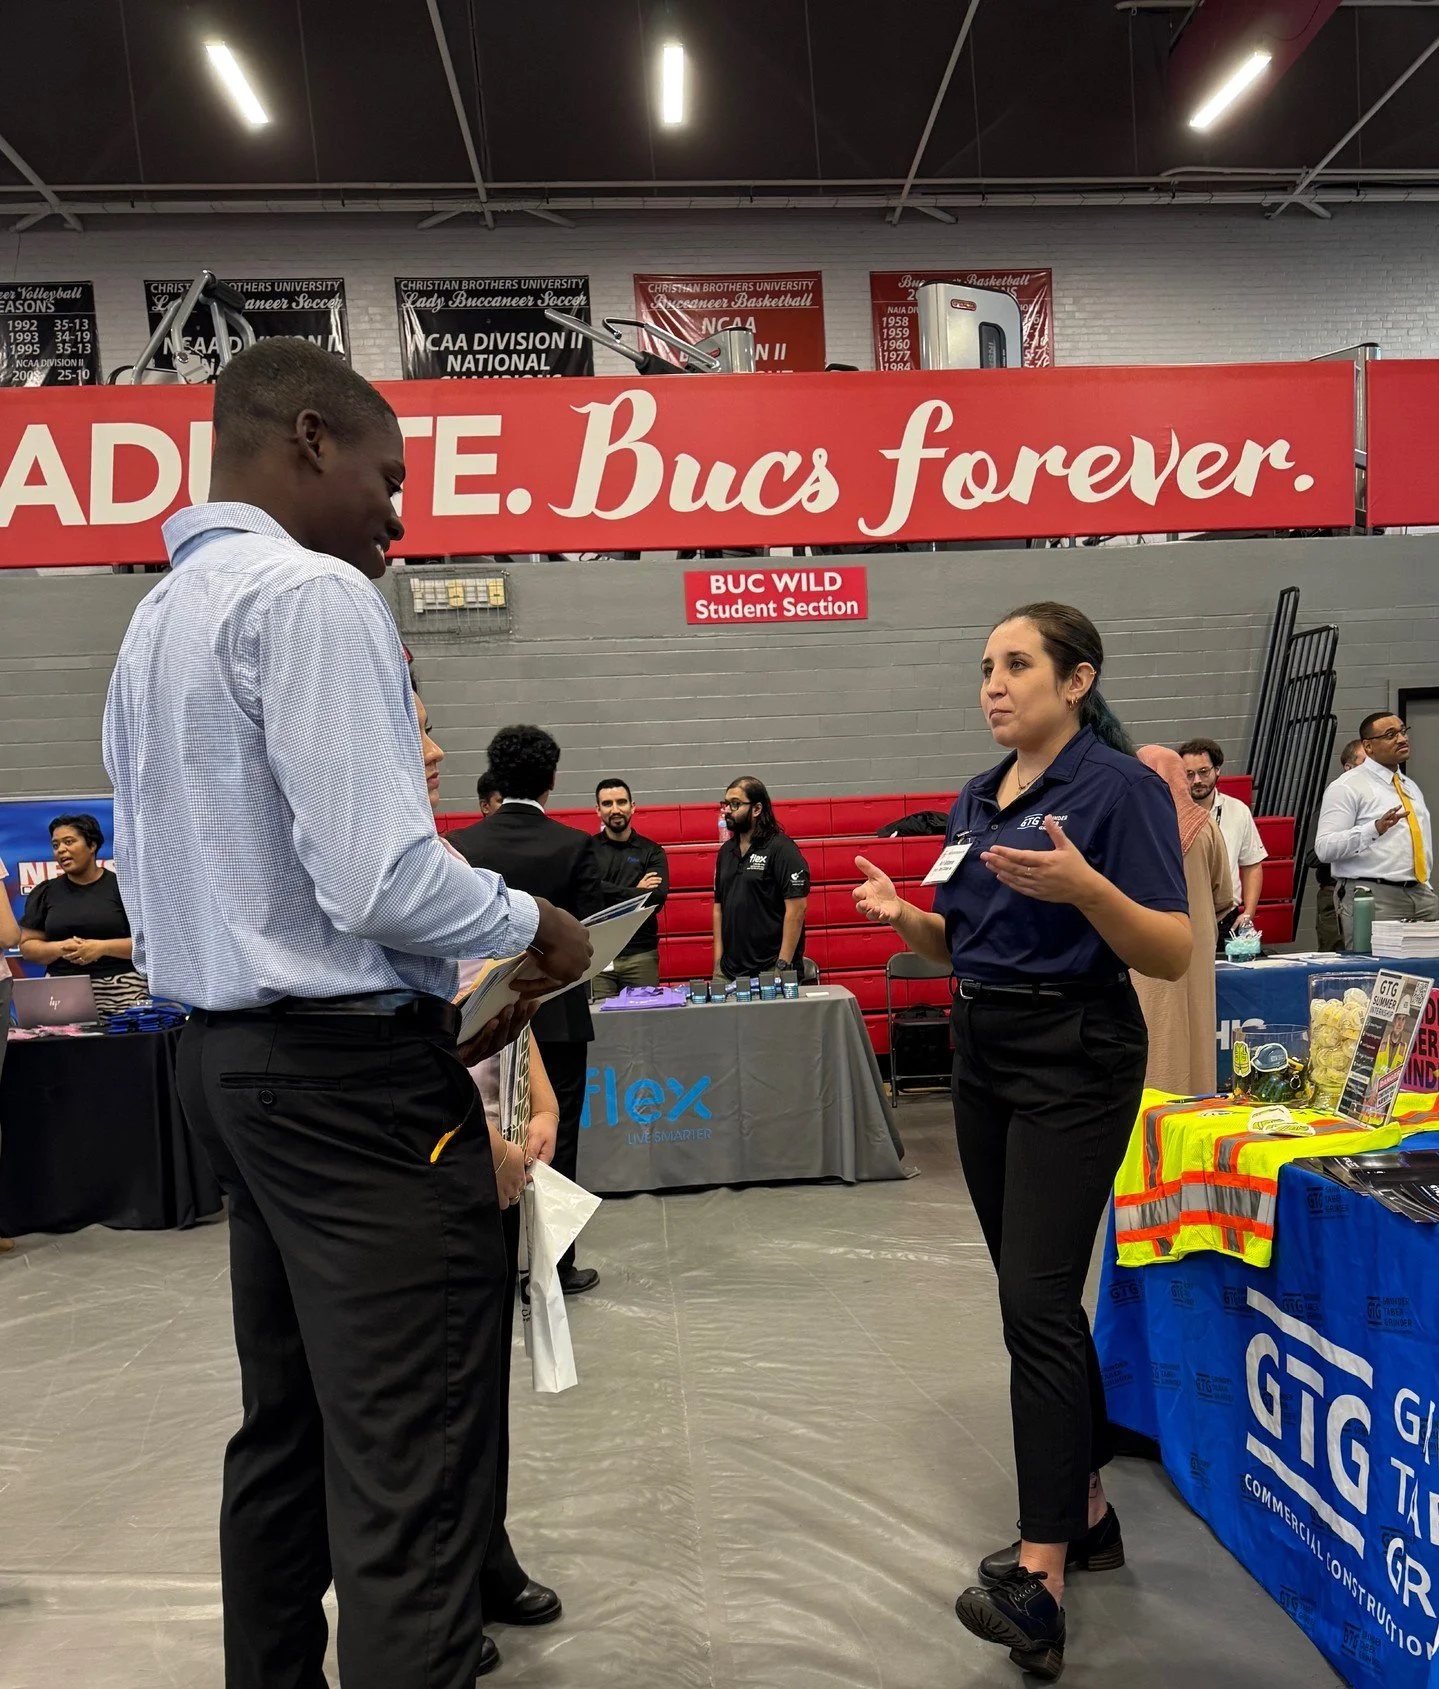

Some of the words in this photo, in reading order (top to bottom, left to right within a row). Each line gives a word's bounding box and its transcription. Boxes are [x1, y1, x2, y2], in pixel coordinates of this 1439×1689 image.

[150, 283, 191, 293] CHRIST
[229, 282, 272, 292] OTHERS
[274, 281, 340, 291] UNIVERSITY
[400, 280, 461, 291] CHRISTIAN
[461, 279, 519, 290] BROTHERS
[520, 278, 585, 289] UNIVERSITY
[647, 282, 700, 293] CHRISTIAN
[702, 281, 754, 292] BROTHERS
[756, 280, 815, 291] UNIVERSITY
[17, 286, 82, 302] Volleyball
[401, 292, 445, 313] Lady
[448, 291, 535, 307] Buccaneer
[538, 290, 587, 307] Soccer
[650, 293, 729, 310] Buccaneer
[731, 291, 813, 308] Basketball
[887, 306, 907, 314] NAIA
[7, 320, 38, 331] 1992
[54, 319, 89, 330] 35-13
[882, 316, 909, 327] 1958
[9, 332, 39, 343] 1993
[55, 331, 91, 342] 34-19
[882, 328, 910, 339] 1959
[10, 344, 40, 355] 1995
[56, 343, 92, 354] 35-13
[411, 333, 468, 351] NCAA
[473, 332, 566, 351] DIVISION
[570, 332, 583, 349] II
[883, 339, 911, 350] 1960
[16, 360, 39, 368] NCAA
[41, 359, 77, 367] DIVISION
[78, 358, 84, 366] II
[446, 353, 550, 372] NATIONAL
[883, 351, 911, 361] 1977
[884, 362, 911, 371] 1984
[57, 369, 90, 380] 25-10
[0, 414, 532, 527] ADTE.
[548, 389, 841, 520] Bucs
[857, 398, 1315, 536] forever.
[709, 573, 766, 595] BUC
[771, 571, 843, 593] WILD
[695, 598, 778, 619] Student
[782, 596, 859, 617] Section
[750, 853, 768, 863] flex
[1379, 980, 1400, 997] GTG
[1372, 995, 1398, 1010] SUMMER
[581, 1066, 712, 1128] flex
[627, 1132, 650, 1145] LIVE
[654, 1127, 712, 1144] SMARTER
[1110, 1282, 1140, 1299] GTG
[1367, 1301, 1383, 1320] GTG
[1246, 1333, 1372, 1515] GTG
[1245, 1473, 1324, 1562] COMMERCIAL
